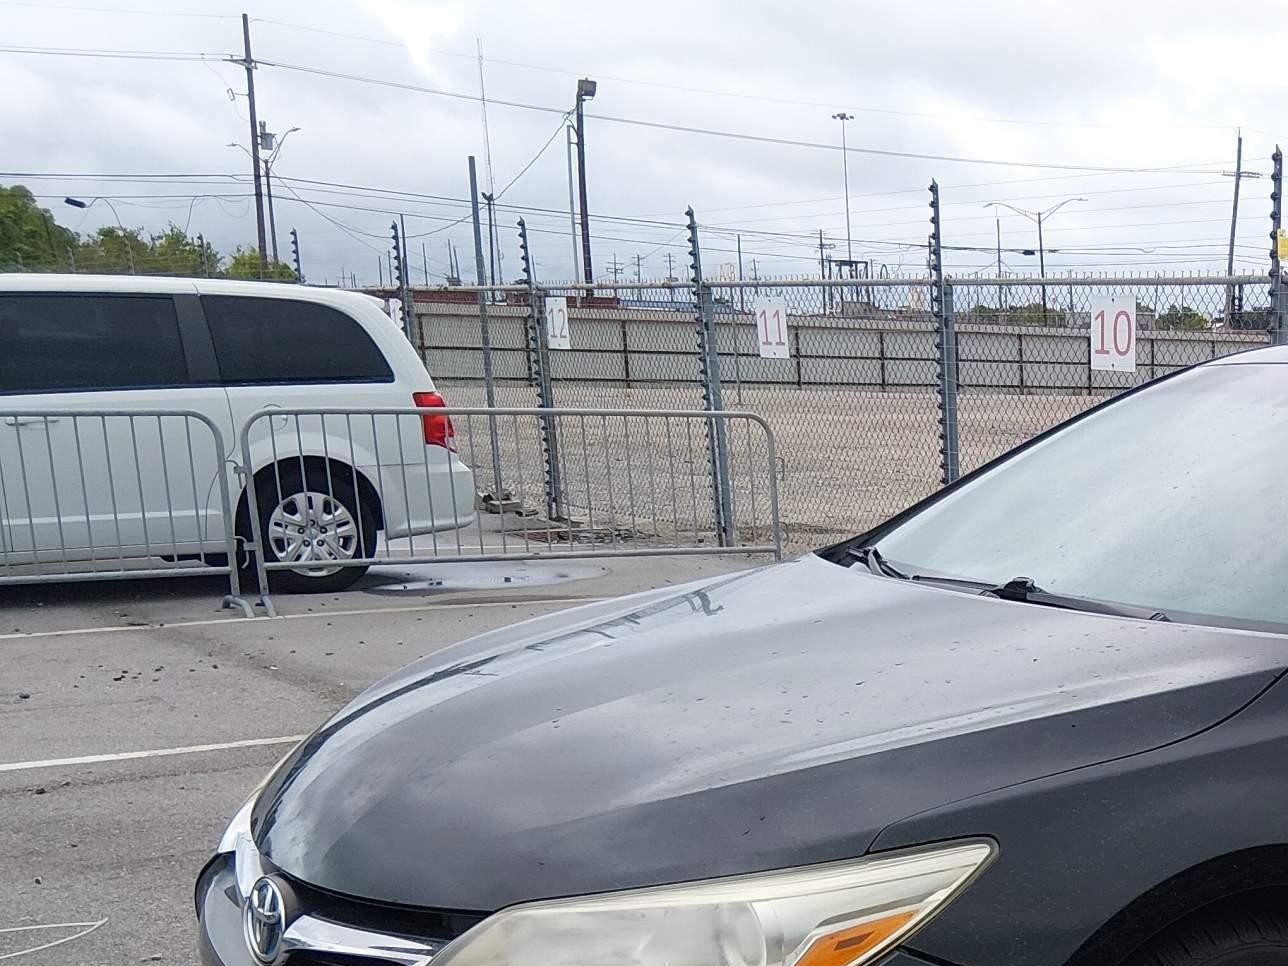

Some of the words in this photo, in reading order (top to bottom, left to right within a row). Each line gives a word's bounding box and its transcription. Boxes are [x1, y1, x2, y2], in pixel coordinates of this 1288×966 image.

[547, 307, 568, 339] 12
[759, 309, 785, 346] 11
[1094, 310, 1132, 357] 10
